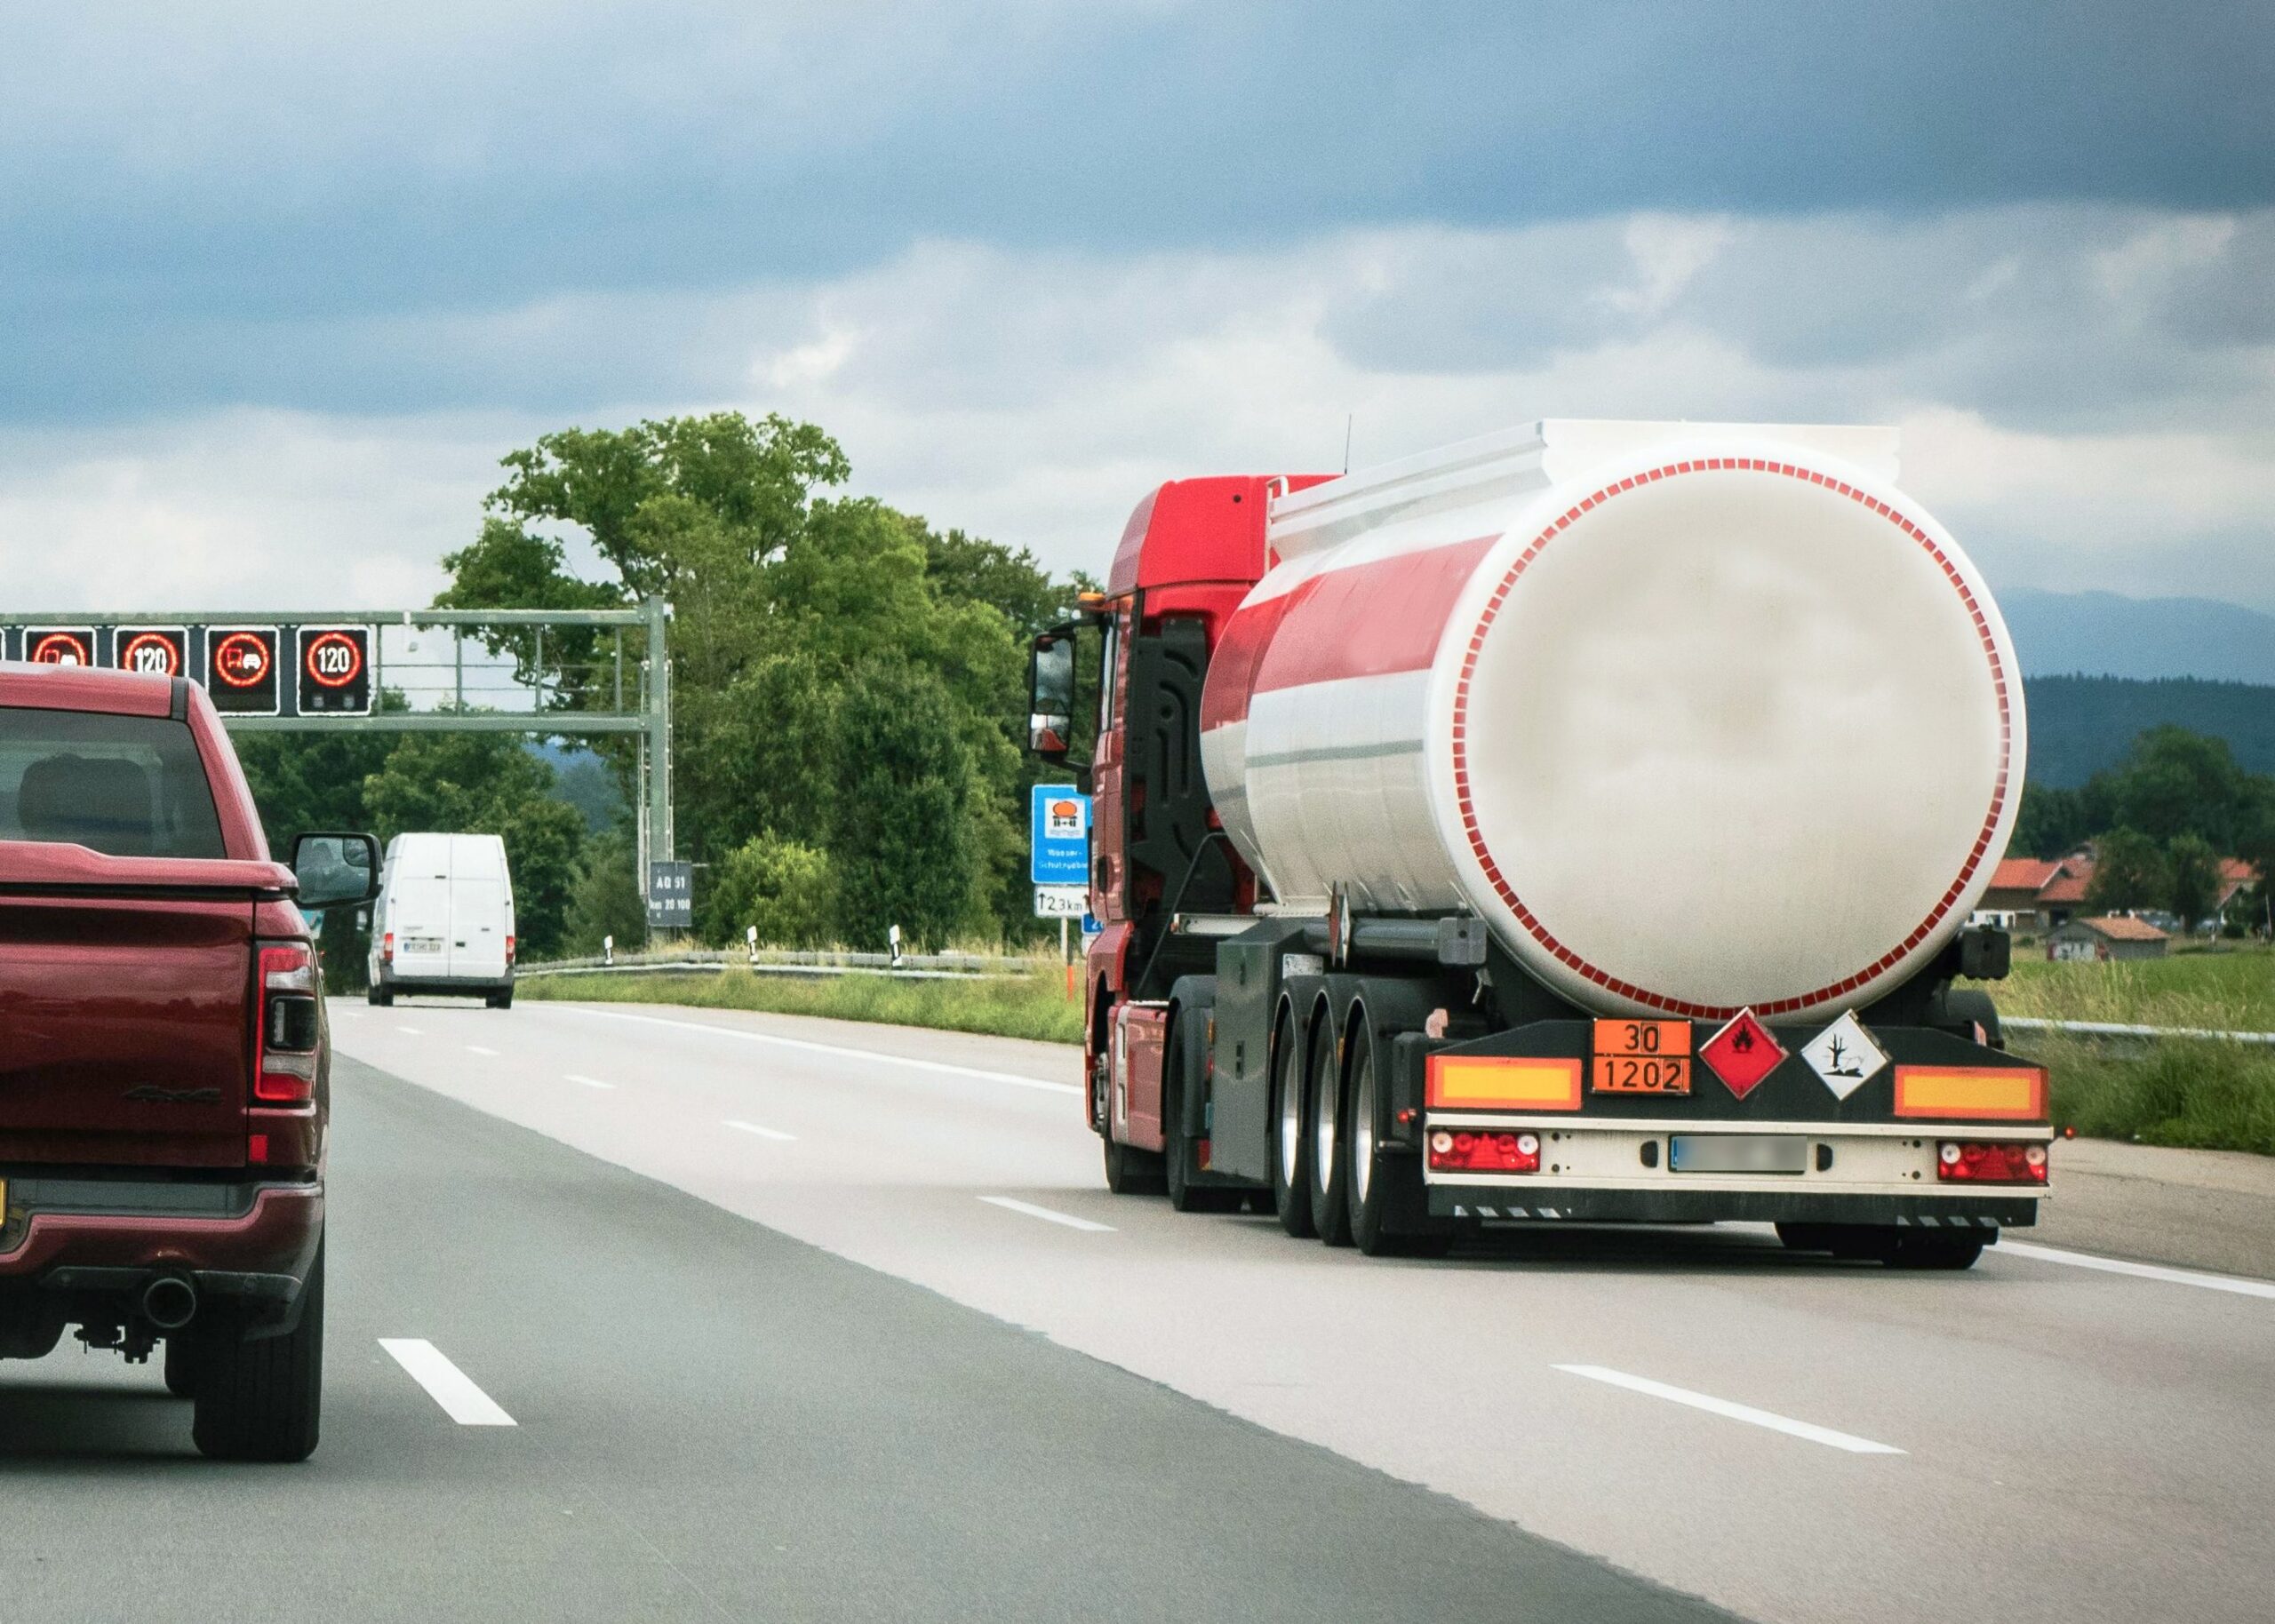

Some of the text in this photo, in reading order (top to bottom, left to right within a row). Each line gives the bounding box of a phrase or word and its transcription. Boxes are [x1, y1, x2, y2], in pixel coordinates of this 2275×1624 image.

[134, 647, 167, 673] 120
[317, 647, 350, 673] 120
[1624, 1023, 1659, 1053] 30
[1605, 1060, 1681, 1091] 1202
